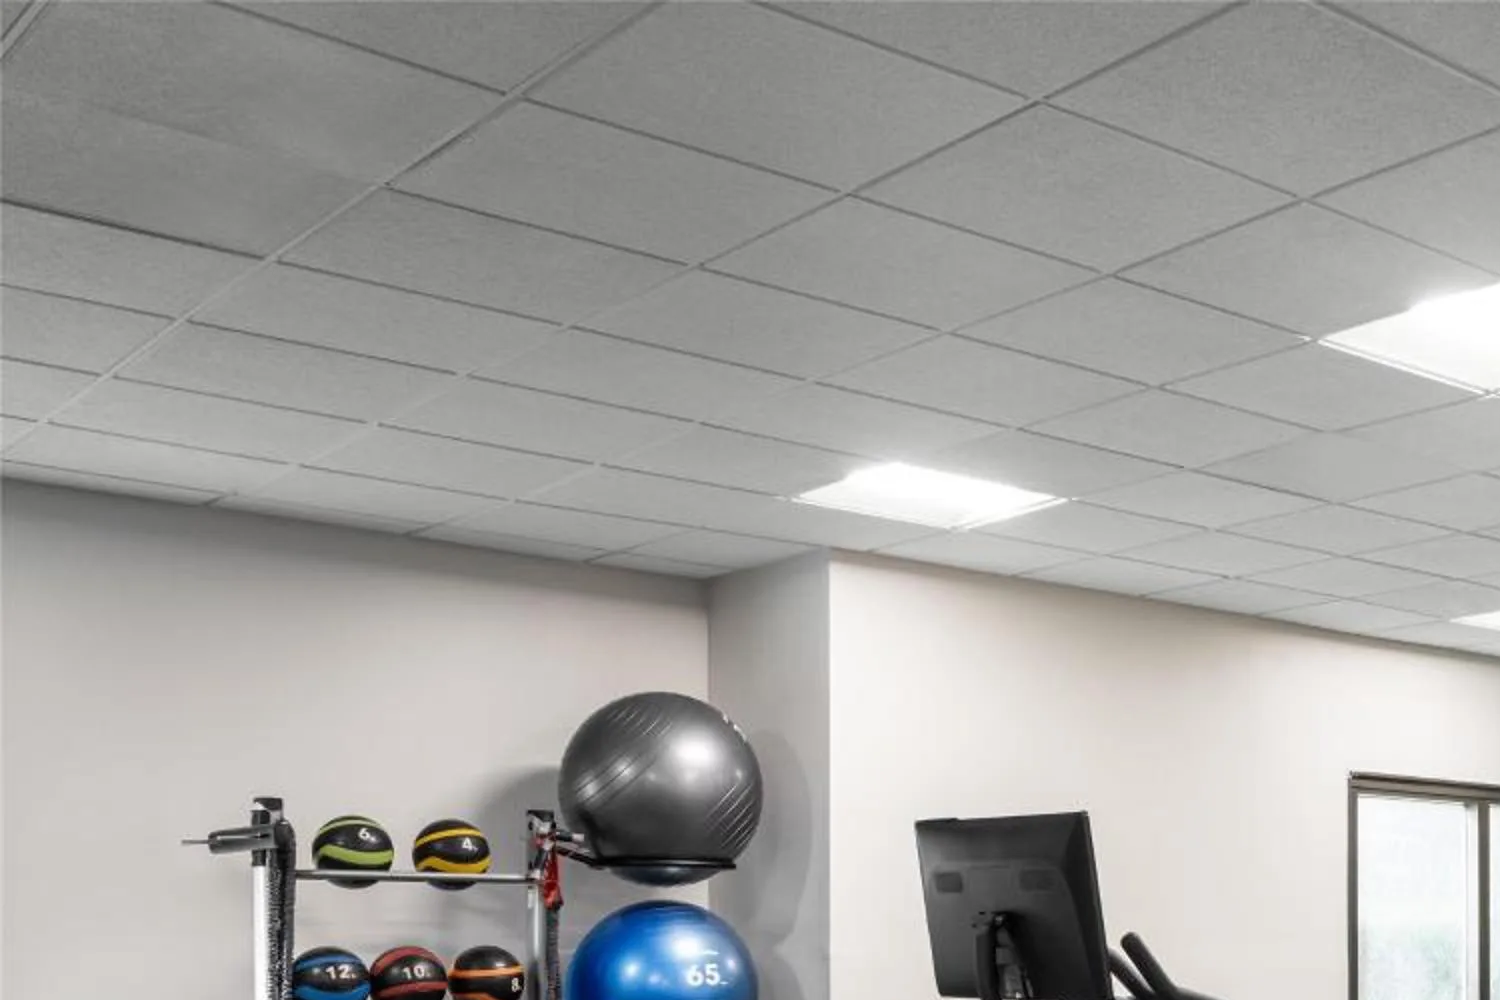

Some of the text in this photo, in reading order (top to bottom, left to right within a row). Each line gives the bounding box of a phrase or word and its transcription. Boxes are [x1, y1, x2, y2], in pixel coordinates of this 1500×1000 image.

[358, 827, 370, 840] 6
[462, 837, 474, 851] 4
[326, 964, 351, 980] 12
[403, 965, 425, 980] 10
[687, 963, 720, 987] 65
